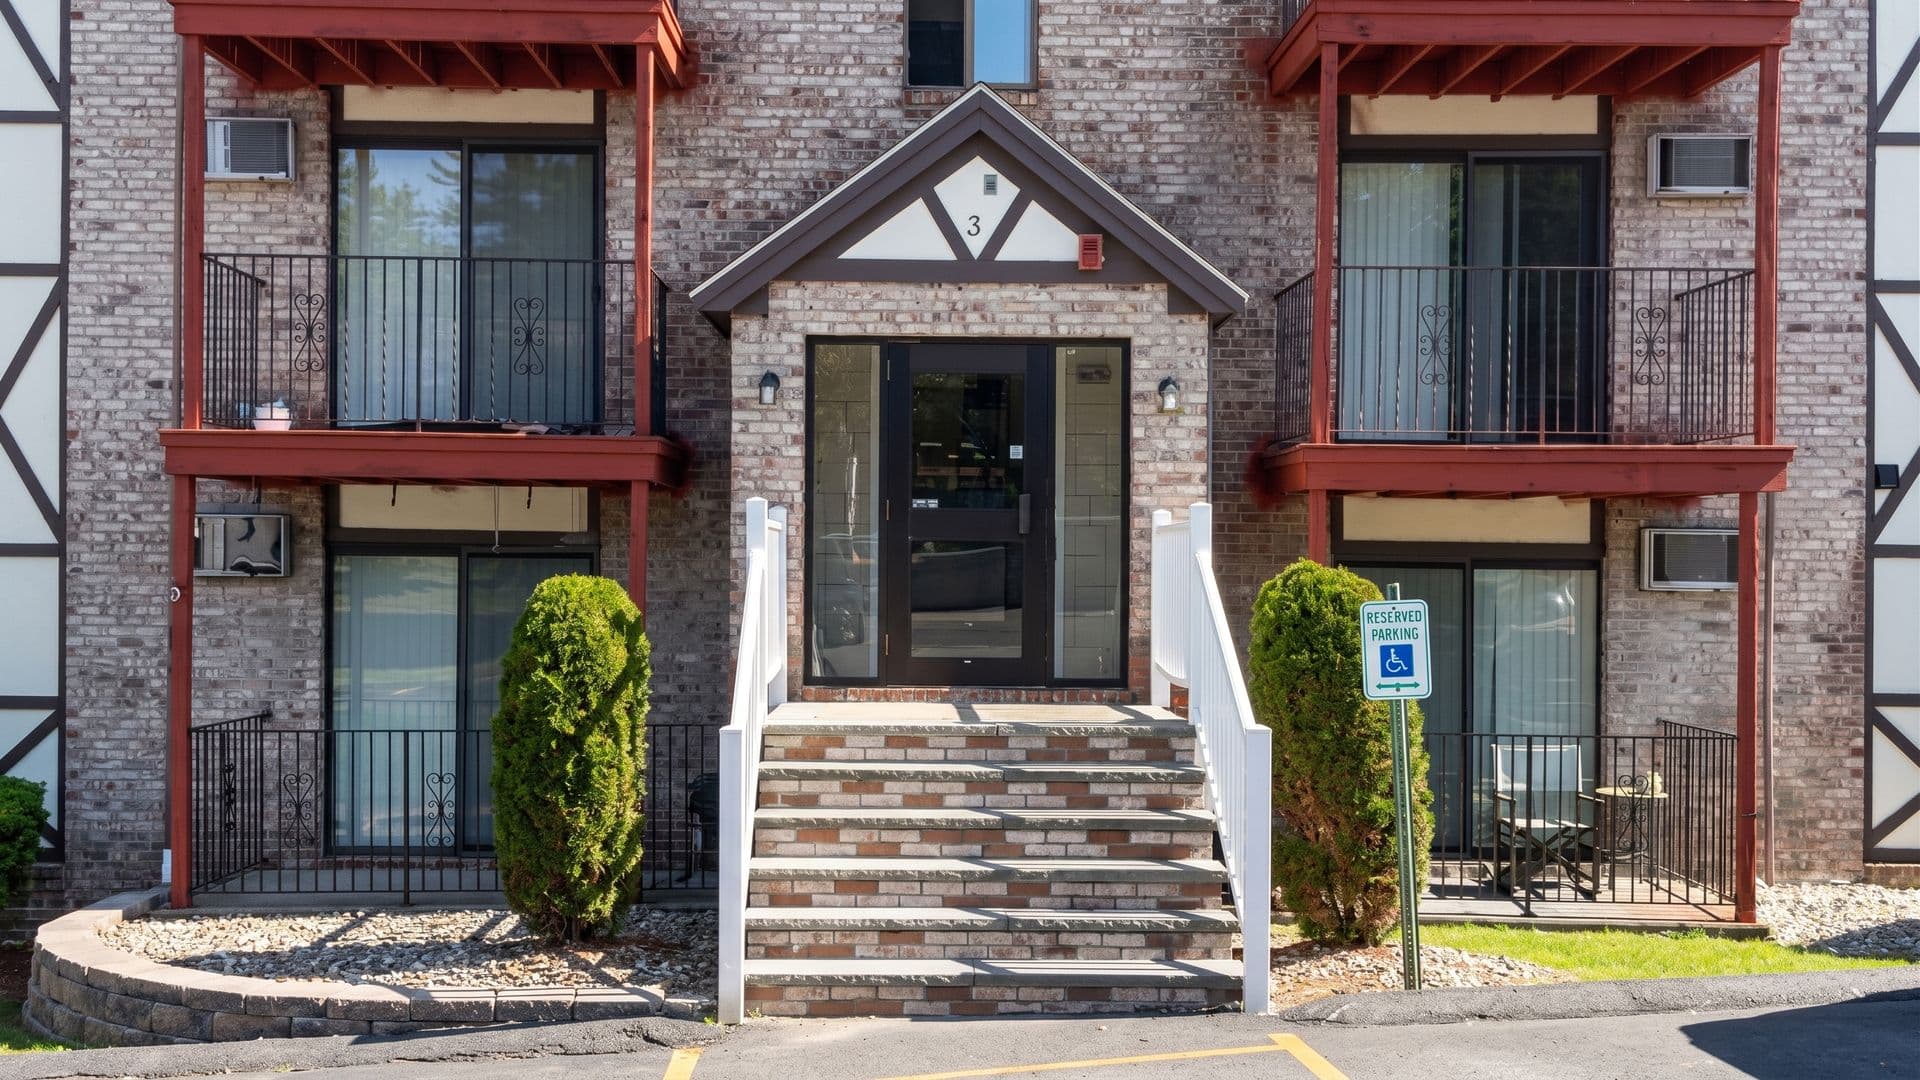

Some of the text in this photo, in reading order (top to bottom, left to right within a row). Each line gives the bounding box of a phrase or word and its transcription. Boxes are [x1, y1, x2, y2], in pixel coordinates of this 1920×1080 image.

[967, 215, 980, 236] 3
[1367, 610, 1422, 624] RESERVED
[1372, 627, 1419, 641] PARKING
